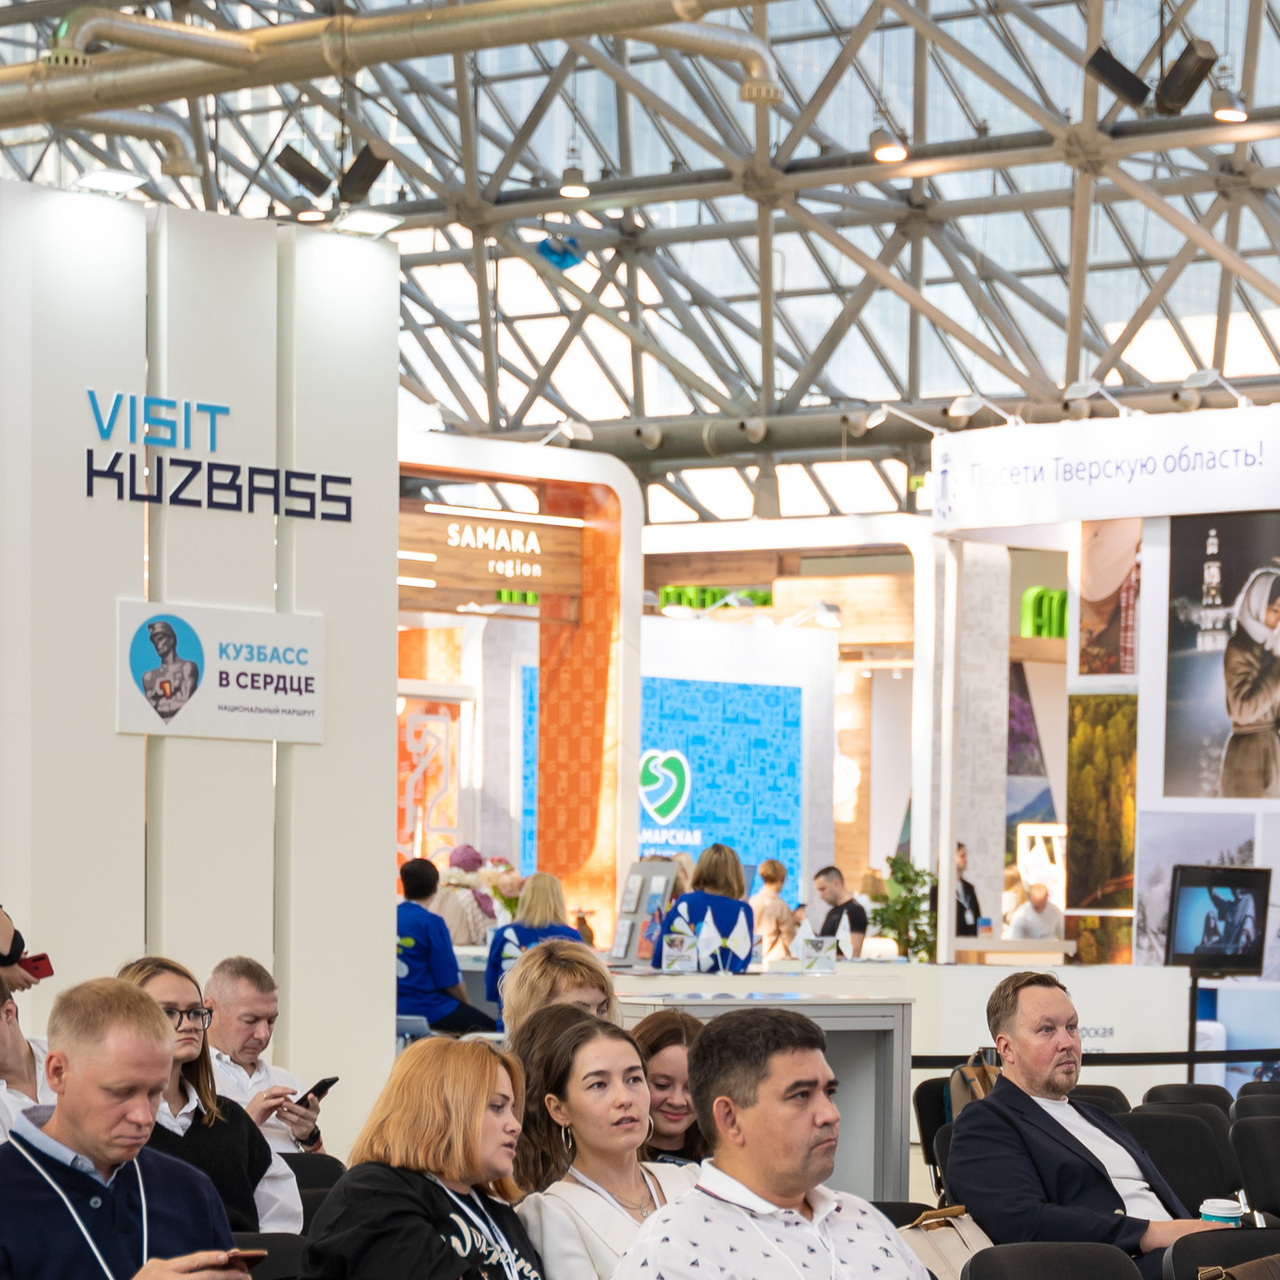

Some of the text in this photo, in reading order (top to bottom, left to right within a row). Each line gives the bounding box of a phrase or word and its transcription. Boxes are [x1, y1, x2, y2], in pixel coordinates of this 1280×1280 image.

[86, 389, 230, 452] VISIT
[1053, 456, 1157, 487] Тверскую
[1163, 441, 1264, 474] область!
[86, 448, 352, 523] KUZBASS
[447, 523, 541, 555] SAMARA
[488, 559, 542, 578] region
[218, 642, 309, 666] КУЗБАСС
[218, 671, 315, 696] В СЕРДЦЕ
[217, 704, 315, 718] НАЦИОНАЛЬНЫЙ МАРШРУТ
[638, 829, 701, 846] МАРСКАЯ
[1080, 1027, 1115, 1041] рская
